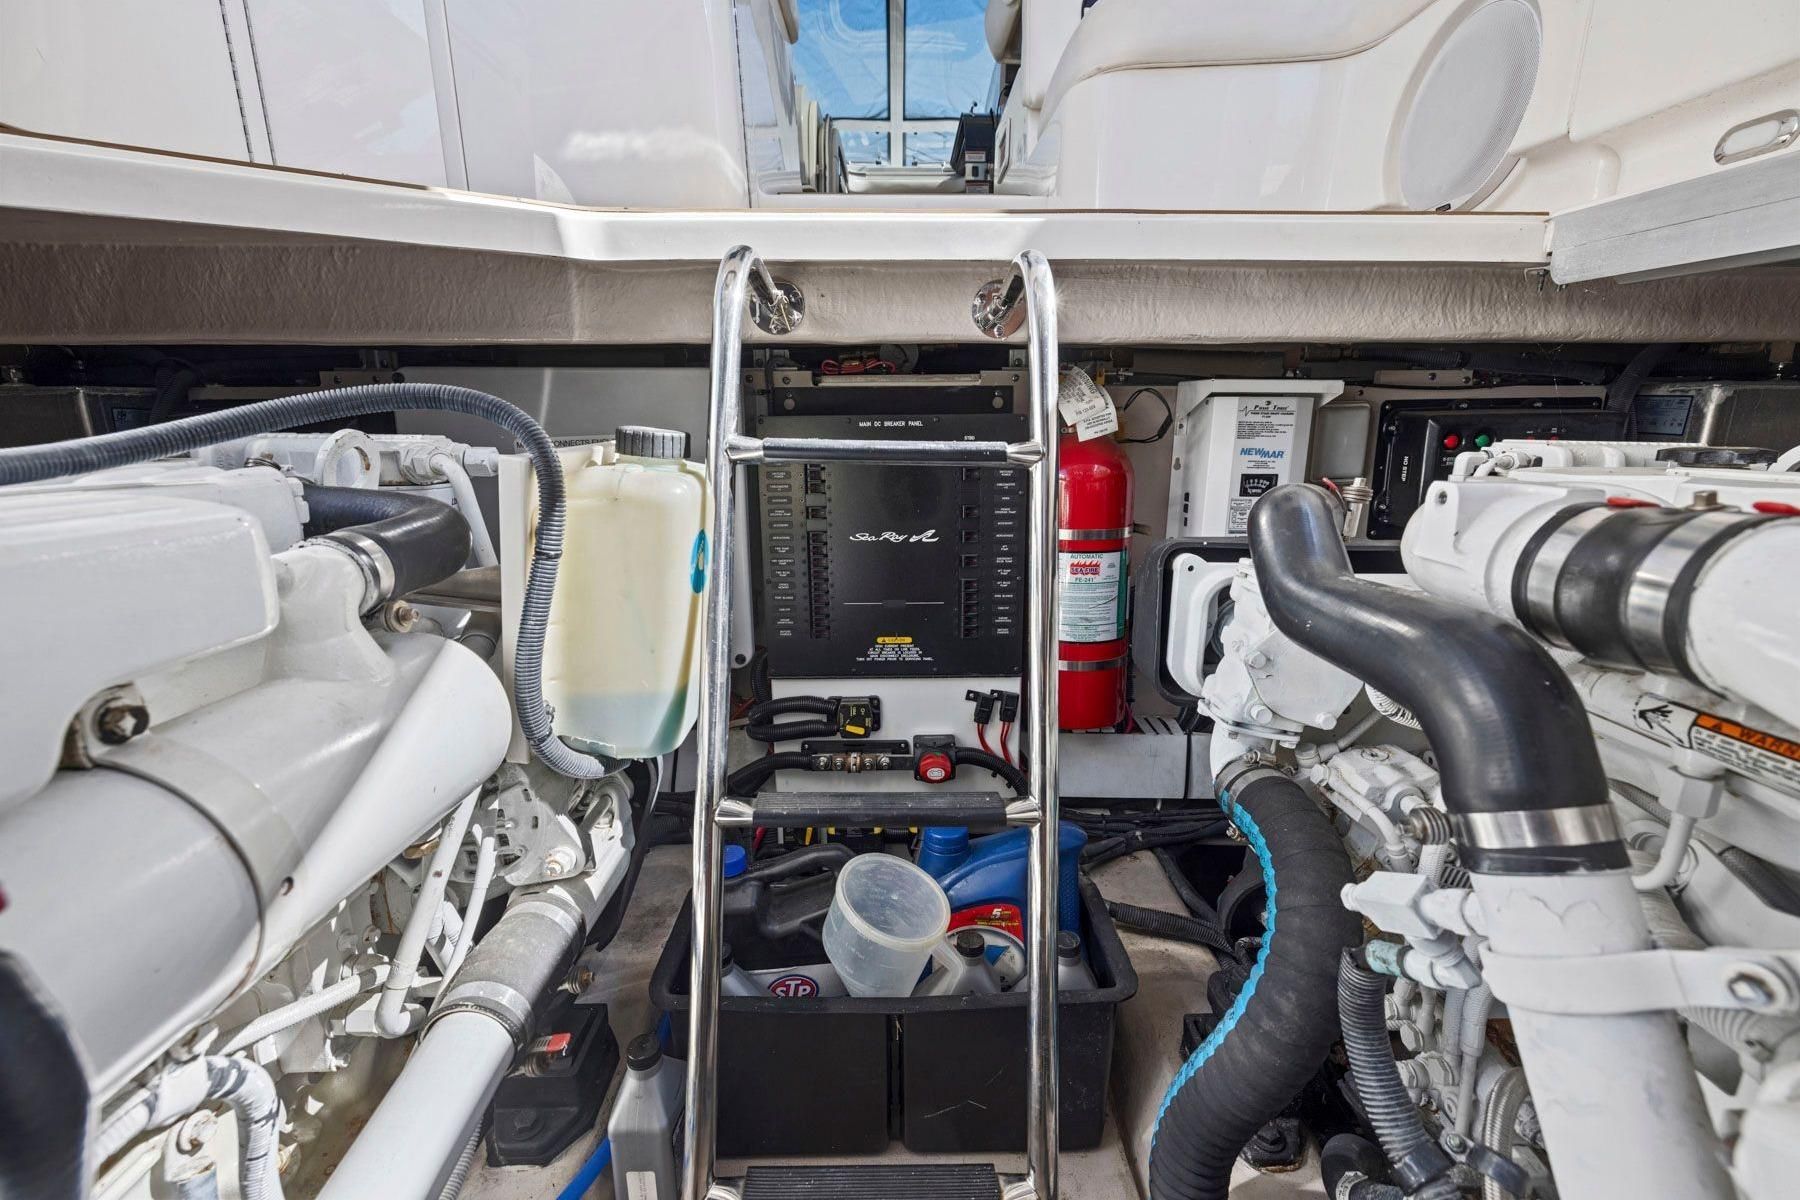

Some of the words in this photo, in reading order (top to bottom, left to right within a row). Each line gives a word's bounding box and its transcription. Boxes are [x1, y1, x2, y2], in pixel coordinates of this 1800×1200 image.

[1240, 447, 1284, 459] NEWMAR
[1403, 456, 1409, 466] NO
[849, 532, 879, 541] Sea
[879, 531, 908, 542] Ray
